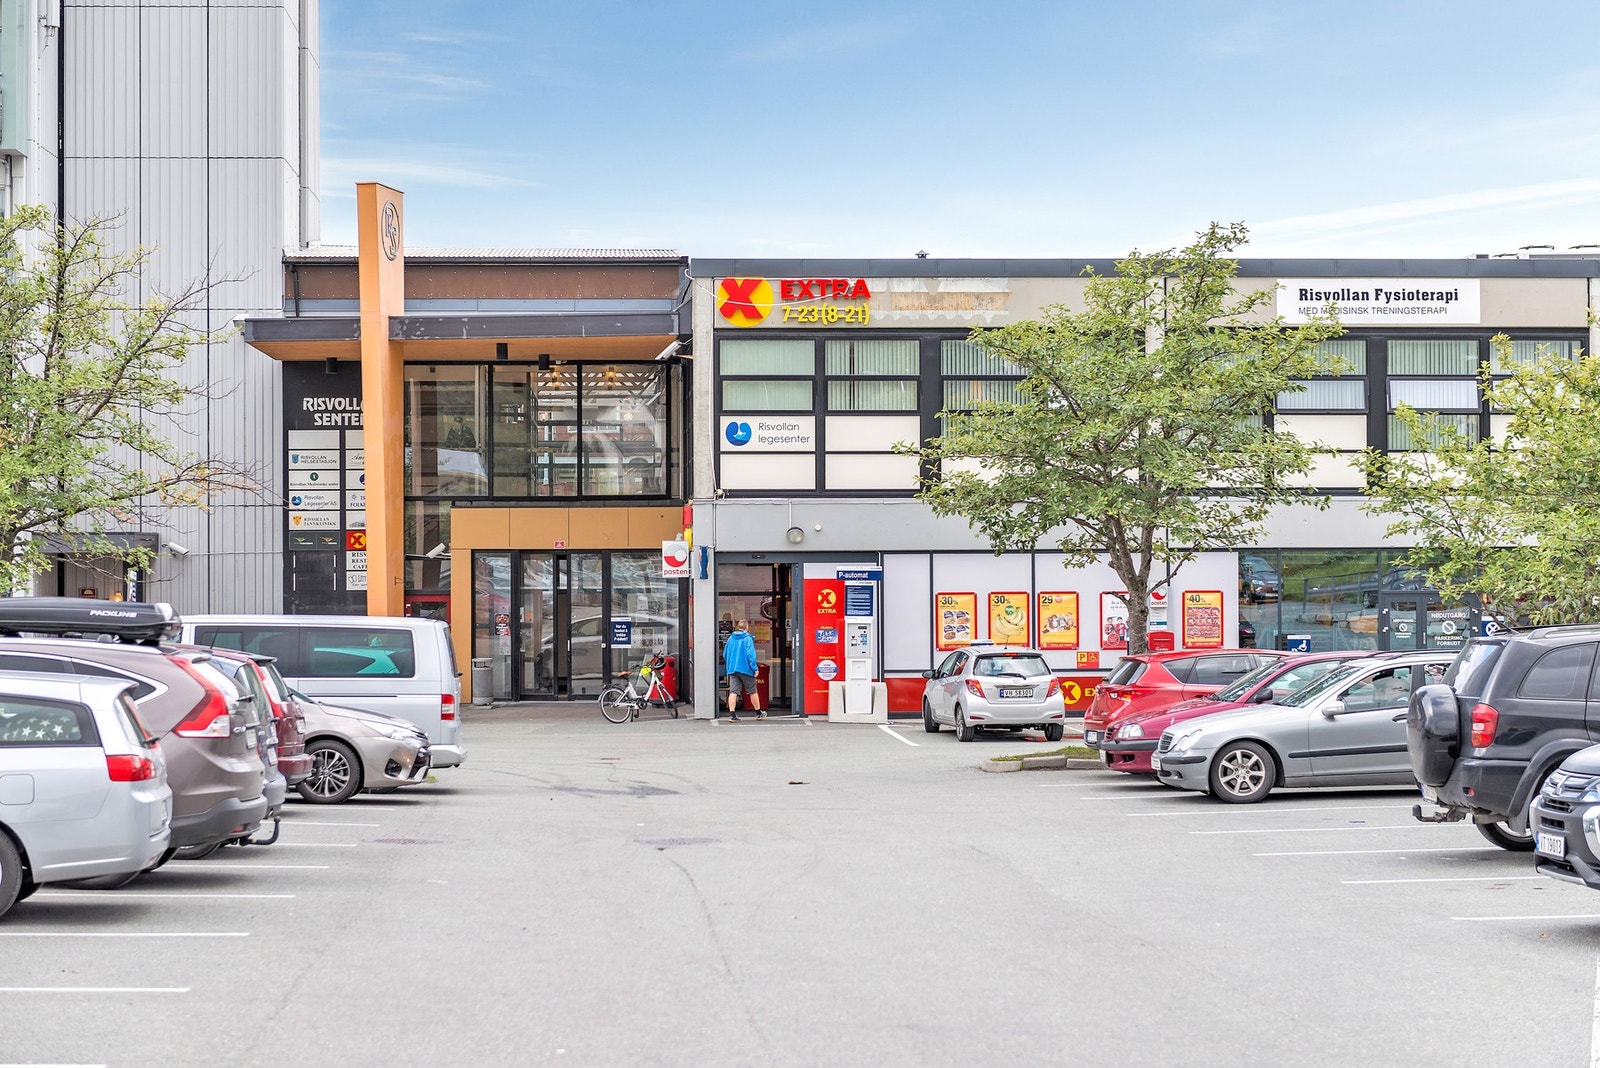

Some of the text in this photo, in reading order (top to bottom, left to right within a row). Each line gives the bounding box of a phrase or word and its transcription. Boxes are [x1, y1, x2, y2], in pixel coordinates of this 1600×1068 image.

[780, 278, 872, 299] EXTRA
[1298, 288, 1459, 304] Risvollan Fysioterapi
[1298, 306, 1319, 315] MED
[1371, 306, 1447, 315] TRENINGSTERAPI
[302, 397, 364, 412] RISVOLL
[758, 422, 800, 431] Risvollan
[758, 434, 810, 445] legesenter
[838, 571, 869, 579] P-automat
[1041, 595, 1053, 604] 29
[1079, 653, 1086, 661] P
